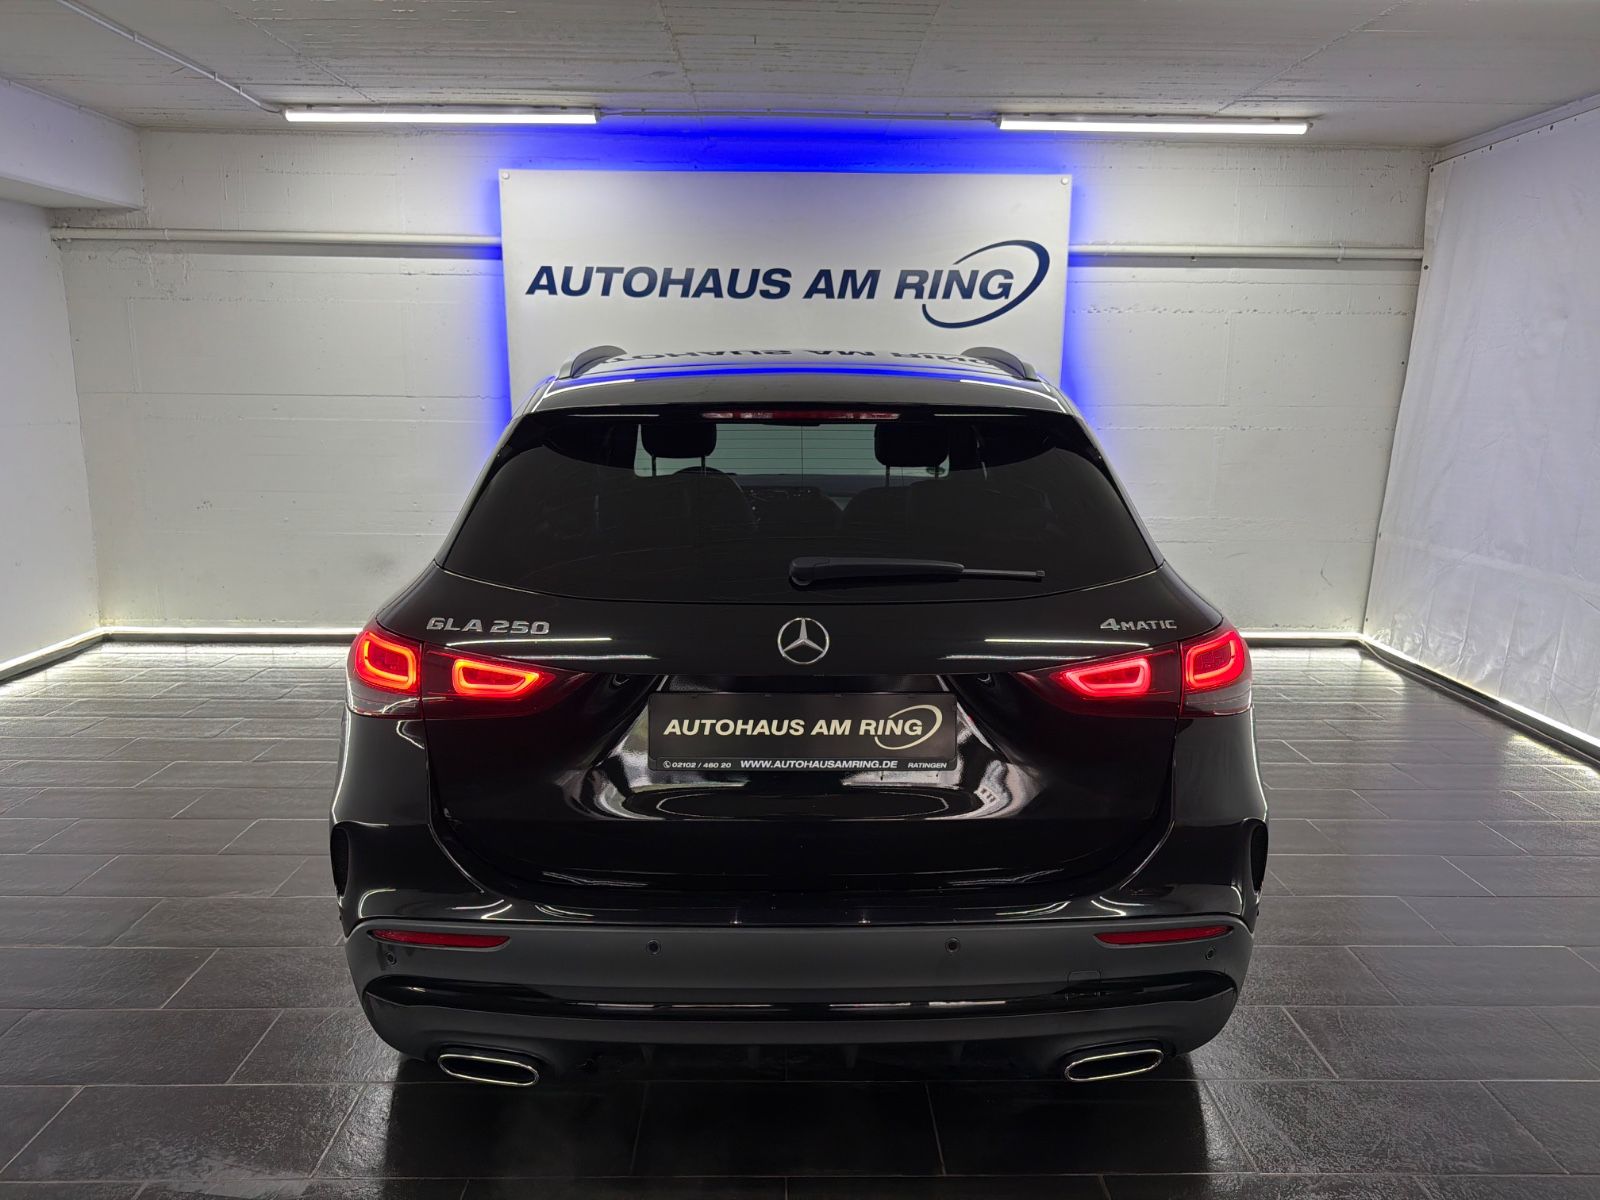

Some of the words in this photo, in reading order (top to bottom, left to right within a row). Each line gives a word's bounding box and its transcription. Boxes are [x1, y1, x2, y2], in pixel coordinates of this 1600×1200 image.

[525, 265, 792, 300] AUTOHAUS
[802, 268, 882, 300] AM
[894, 268, 1015, 301] RING
[426, 617, 483, 632] GLA
[490, 620, 550, 635] 250
[1100, 618, 1177, 631] 4MATIC
[663, 718, 805, 736] AUTOHAUS
[810, 719, 852, 736] AM
[858, 719, 923, 736] RING
[671, 761, 697, 769] 02102
[720, 761, 732, 769] 20
[740, 759, 898, 769] WWW.AUTOHAUSAMRING.DE
[907, 761, 948, 770] RATINGEN
